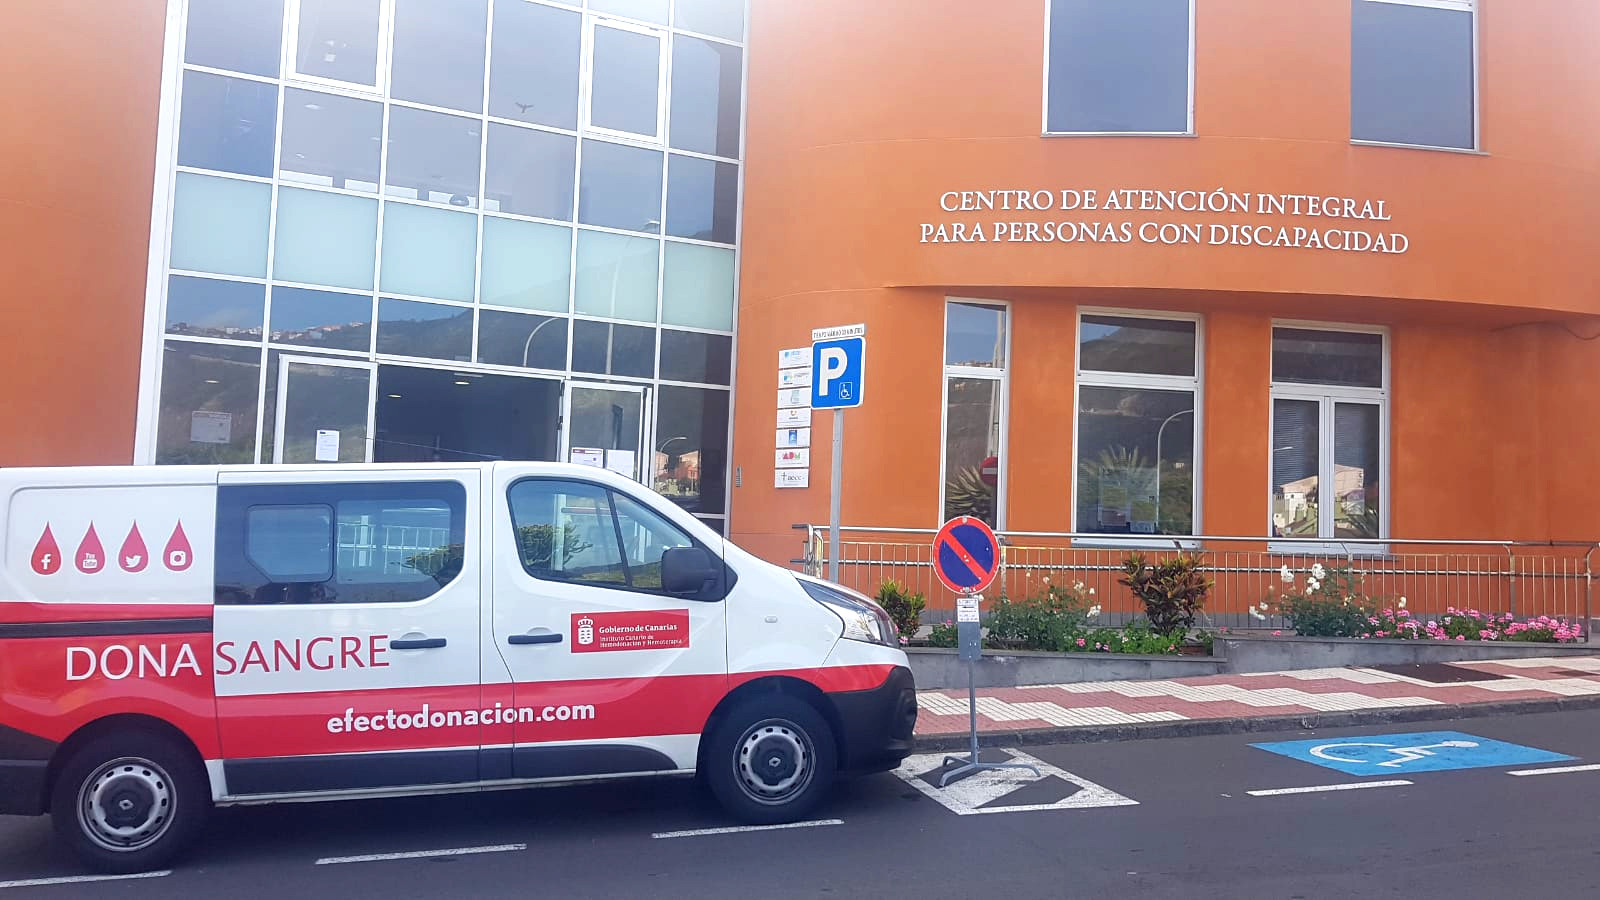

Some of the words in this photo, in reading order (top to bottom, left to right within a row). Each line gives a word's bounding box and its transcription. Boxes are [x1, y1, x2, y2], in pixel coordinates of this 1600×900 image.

[940, 190, 1054, 212] CENTRO
[1060, 189, 1098, 210] DE
[1102, 187, 1251, 213] ATENCIÓN
[1256, 193, 1391, 221] INTEGRAL
[920, 223, 987, 243] PARA
[992, 222, 1132, 243] PERSONAS
[1138, 222, 1203, 244] CON
[1208, 224, 1409, 254] DISCAPACIDAD
[819, 347, 848, 396] P
[599, 625, 635, 634] Gobierno
[635, 624, 644, 632] de
[645, 623, 678, 632] Canarias
[66, 643, 202, 681] DONA
[216, 634, 390, 675] SANGRE
[326, 703, 595, 733] efectodonacion.com
